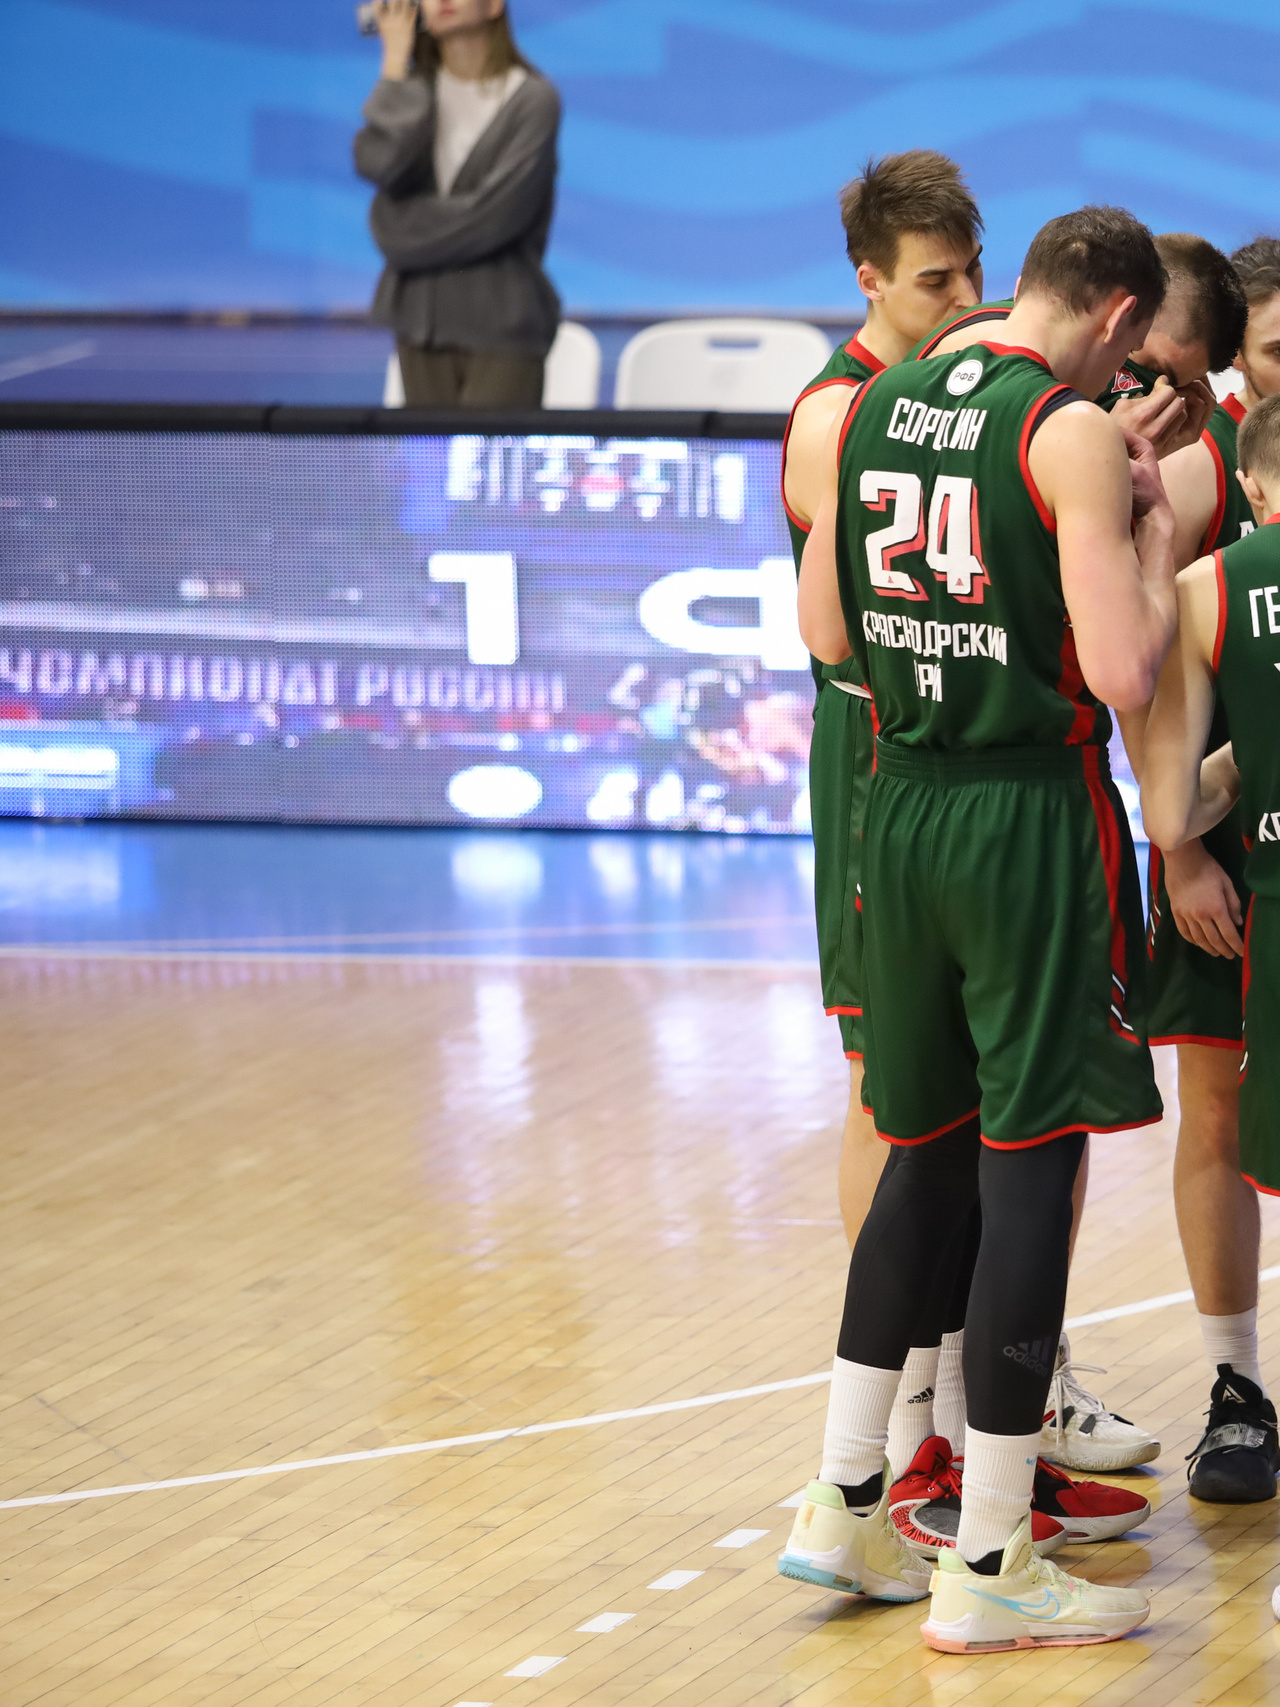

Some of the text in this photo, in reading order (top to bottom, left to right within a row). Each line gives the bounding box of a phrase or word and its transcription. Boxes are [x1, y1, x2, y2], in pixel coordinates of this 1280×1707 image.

[953, 372, 976, 382] РФБ
[859, 470, 989, 602] 24
[428, 550, 519, 666] 1
